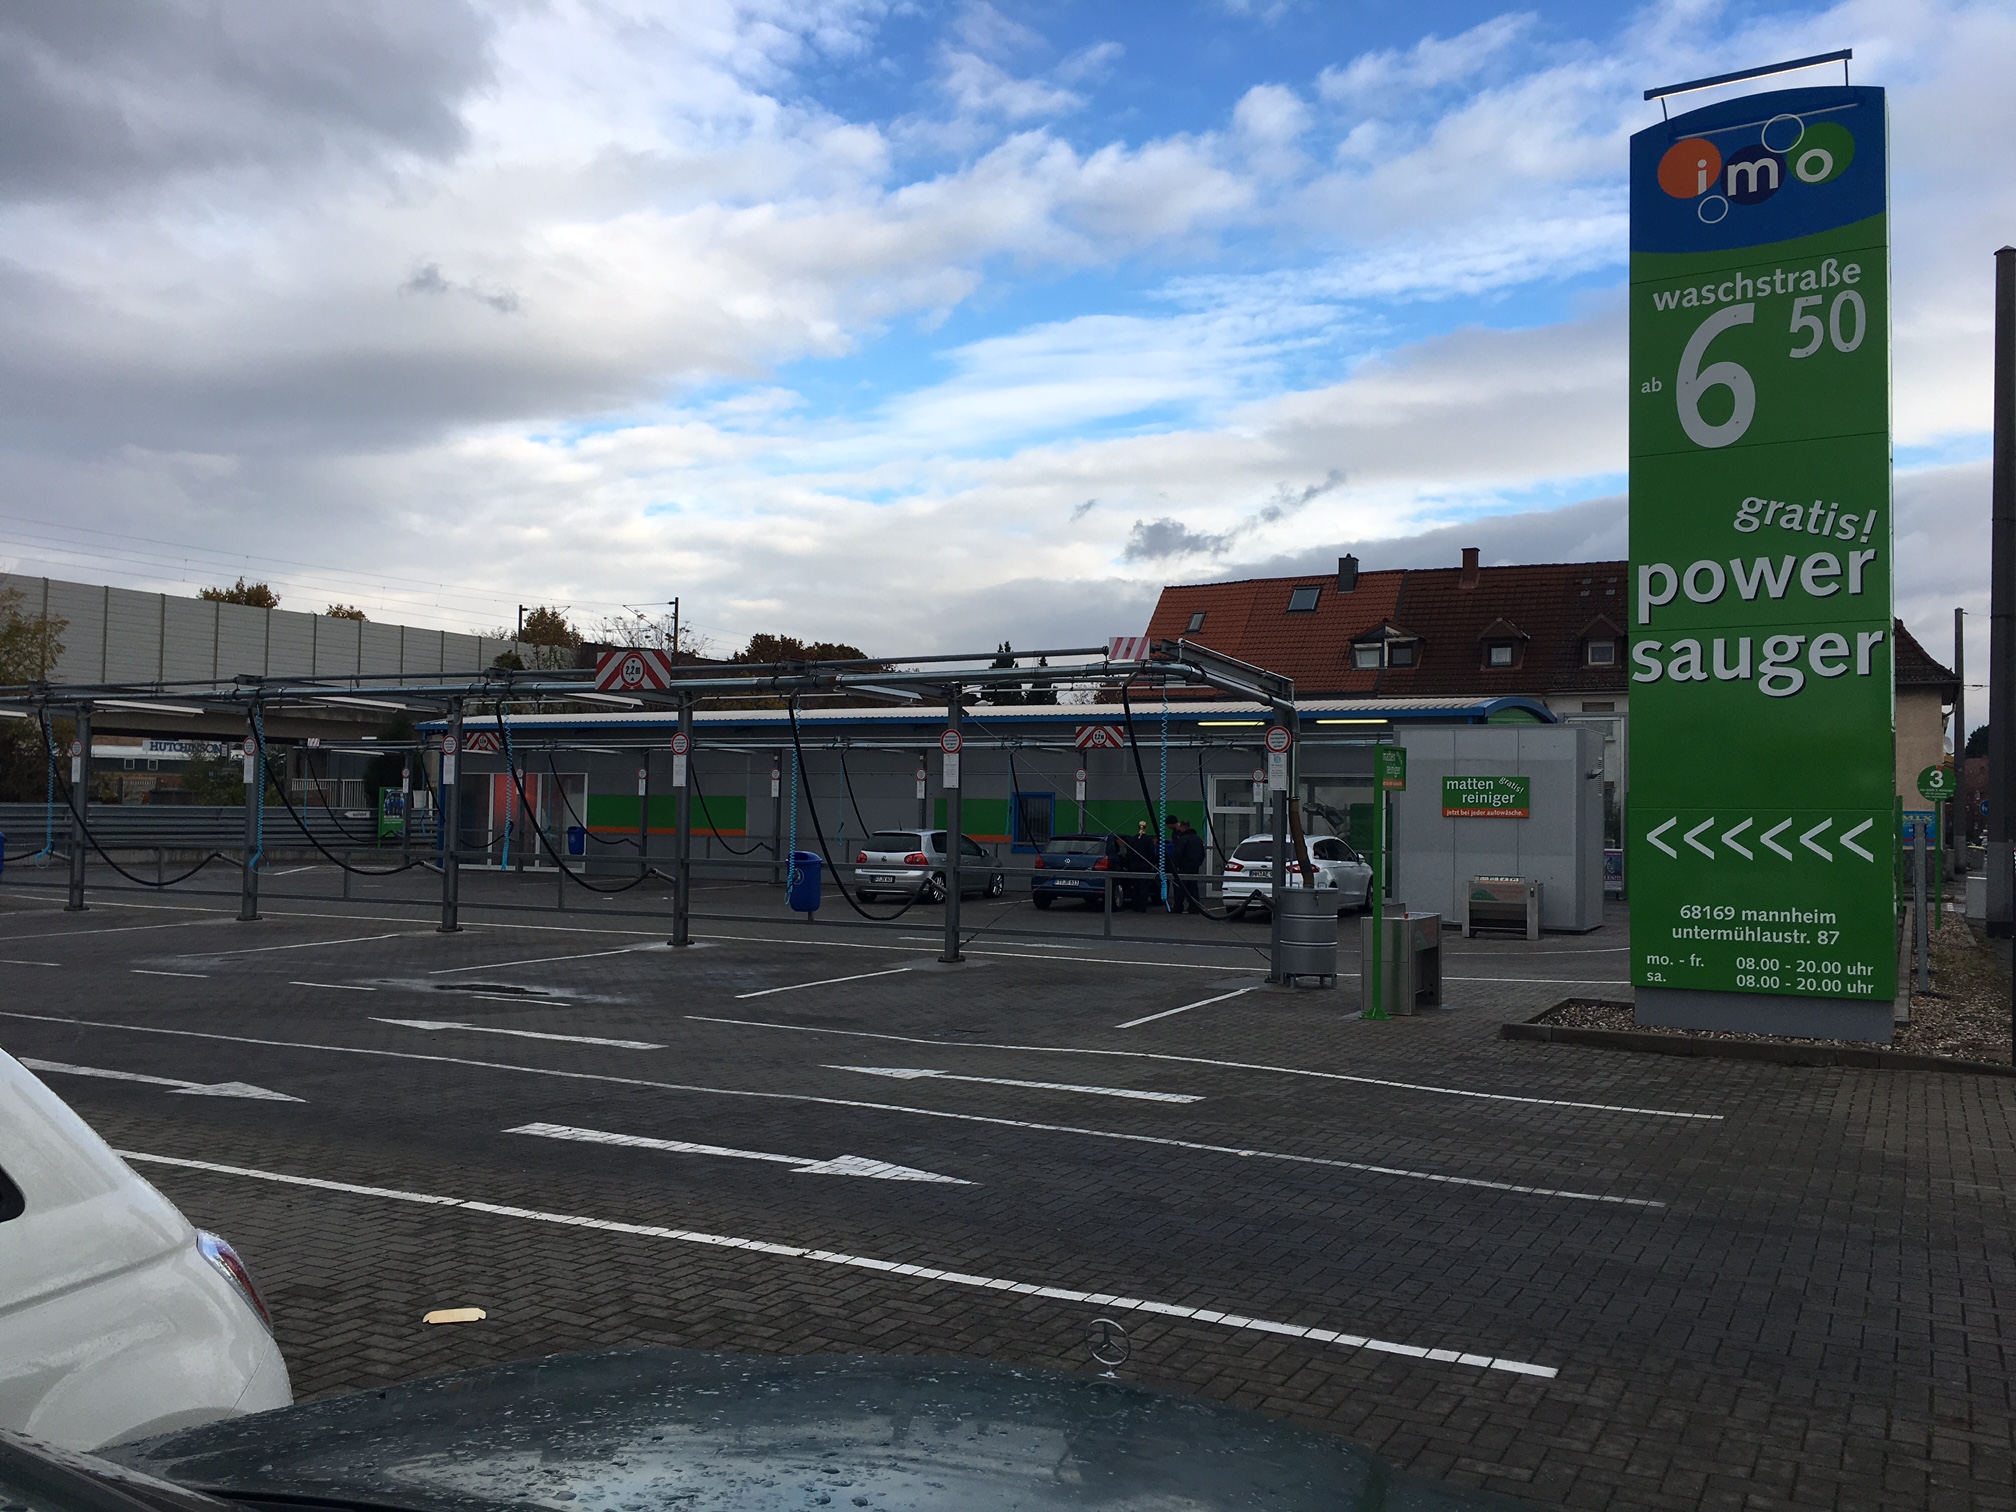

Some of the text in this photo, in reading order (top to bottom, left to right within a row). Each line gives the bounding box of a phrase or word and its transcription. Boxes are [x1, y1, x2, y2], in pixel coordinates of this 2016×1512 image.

[1697, 148, 1834, 197] imo
[1653, 258, 1862, 311] waschstraße
[1641, 288, 1867, 449] ab 6 50
[1734, 496, 1878, 543] gratis!
[1638, 547, 1876, 624] power
[1631, 629, 1884, 697] sauger
[149, 741, 223, 753] HUTCHINSON
[1446, 776, 1525, 794] matten gratis!
[1929, 770, 1944, 788] 3
[1462, 792, 1516, 807] reiniger
[1471, 809, 1486, 817] jeder
[1680, 904, 1837, 925] 68169 mannheim
[1672, 926, 1840, 945] untermühlaustr. 87
[1646, 955, 1674, 966] mo.
[1689, 953, 1705, 967] fr.
[1736, 956, 1780, 971] 08.00
[1796, 959, 1842, 975] 20.00
[1847, 961, 1874, 976] uhr
[1646, 972, 1667, 982] sa.
[1736, 973, 1780, 988] 08.00
[1796, 976, 1842, 992] 20.00
[1847, 979, 1874, 994] uhr
